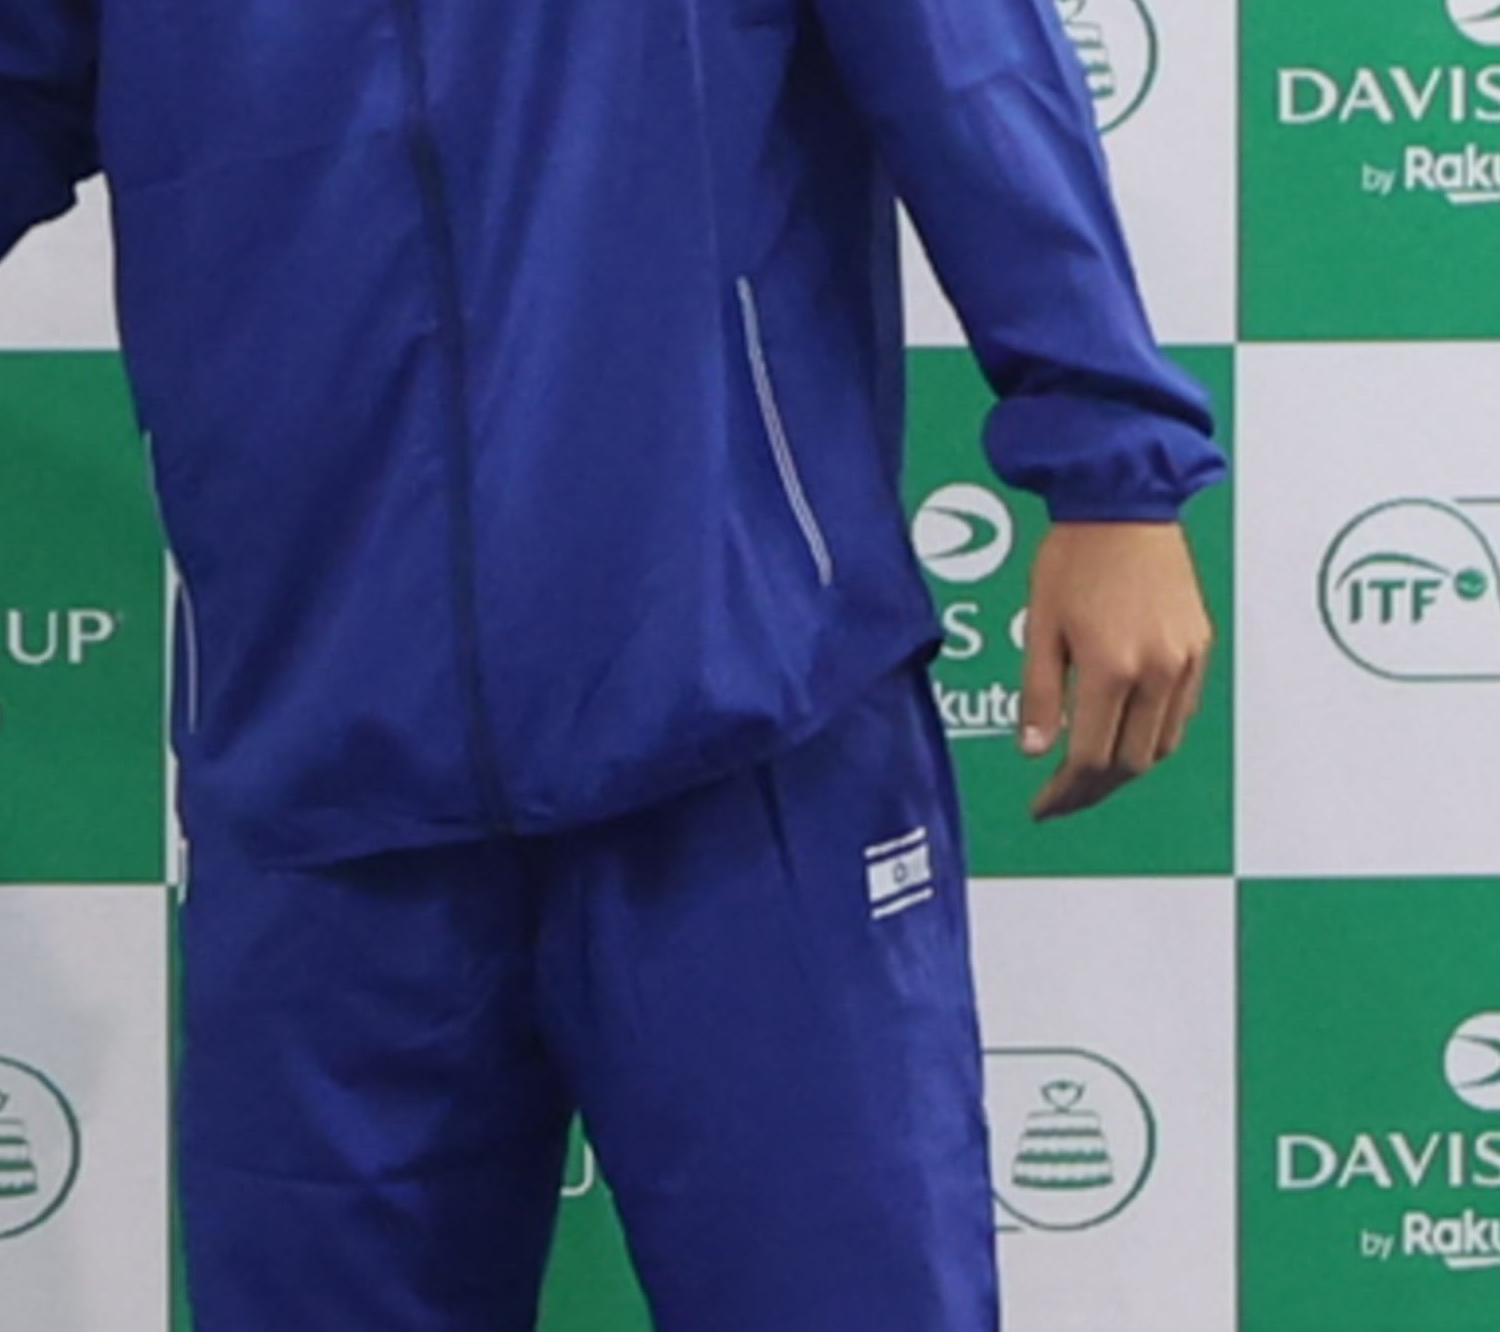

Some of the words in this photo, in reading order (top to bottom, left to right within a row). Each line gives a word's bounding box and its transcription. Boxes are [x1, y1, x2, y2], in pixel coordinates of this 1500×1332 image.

[1361, 162, 1396, 196] by
[1348, 578, 1443, 625] ITF
[1360, 1229, 1395, 1261] by
